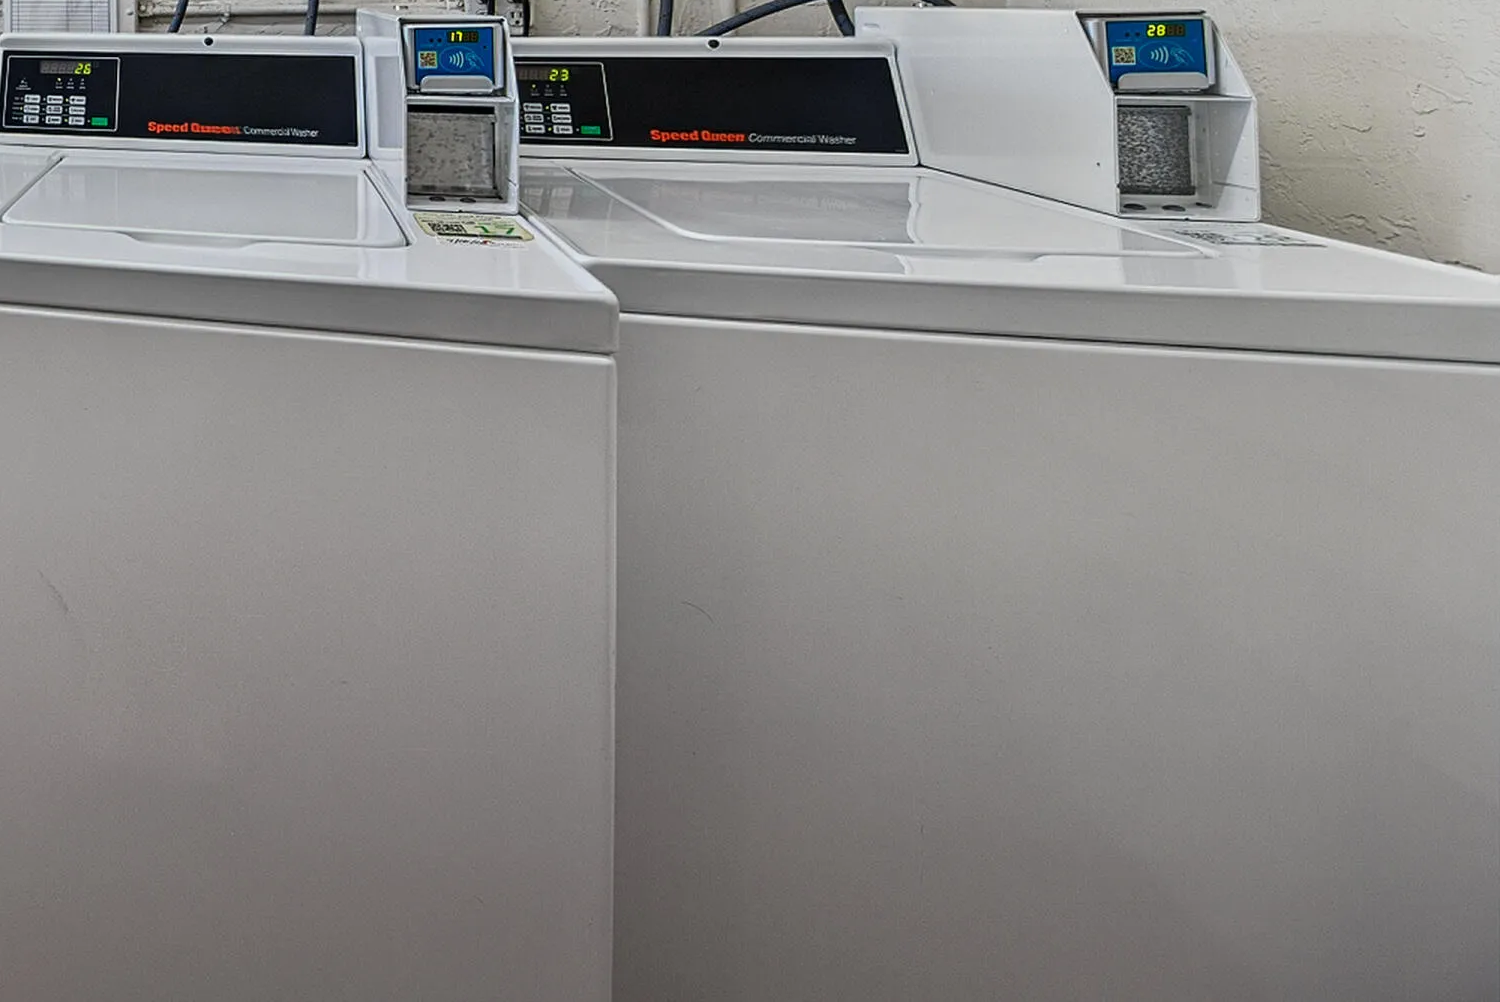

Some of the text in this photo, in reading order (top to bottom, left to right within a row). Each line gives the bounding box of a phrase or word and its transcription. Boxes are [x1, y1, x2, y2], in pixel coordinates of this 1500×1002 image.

[450, 31, 463, 42] 17
[1146, 24, 1166, 37] 28
[74, 62, 92, 75] 26
[549, 68, 570, 81] 23
[148, 121, 189, 133] Speed
[243, 126, 291, 137] Commercial
[291, 128, 320, 138] Washer
[650, 129, 858, 145] Speed Queen Commercial Washer
